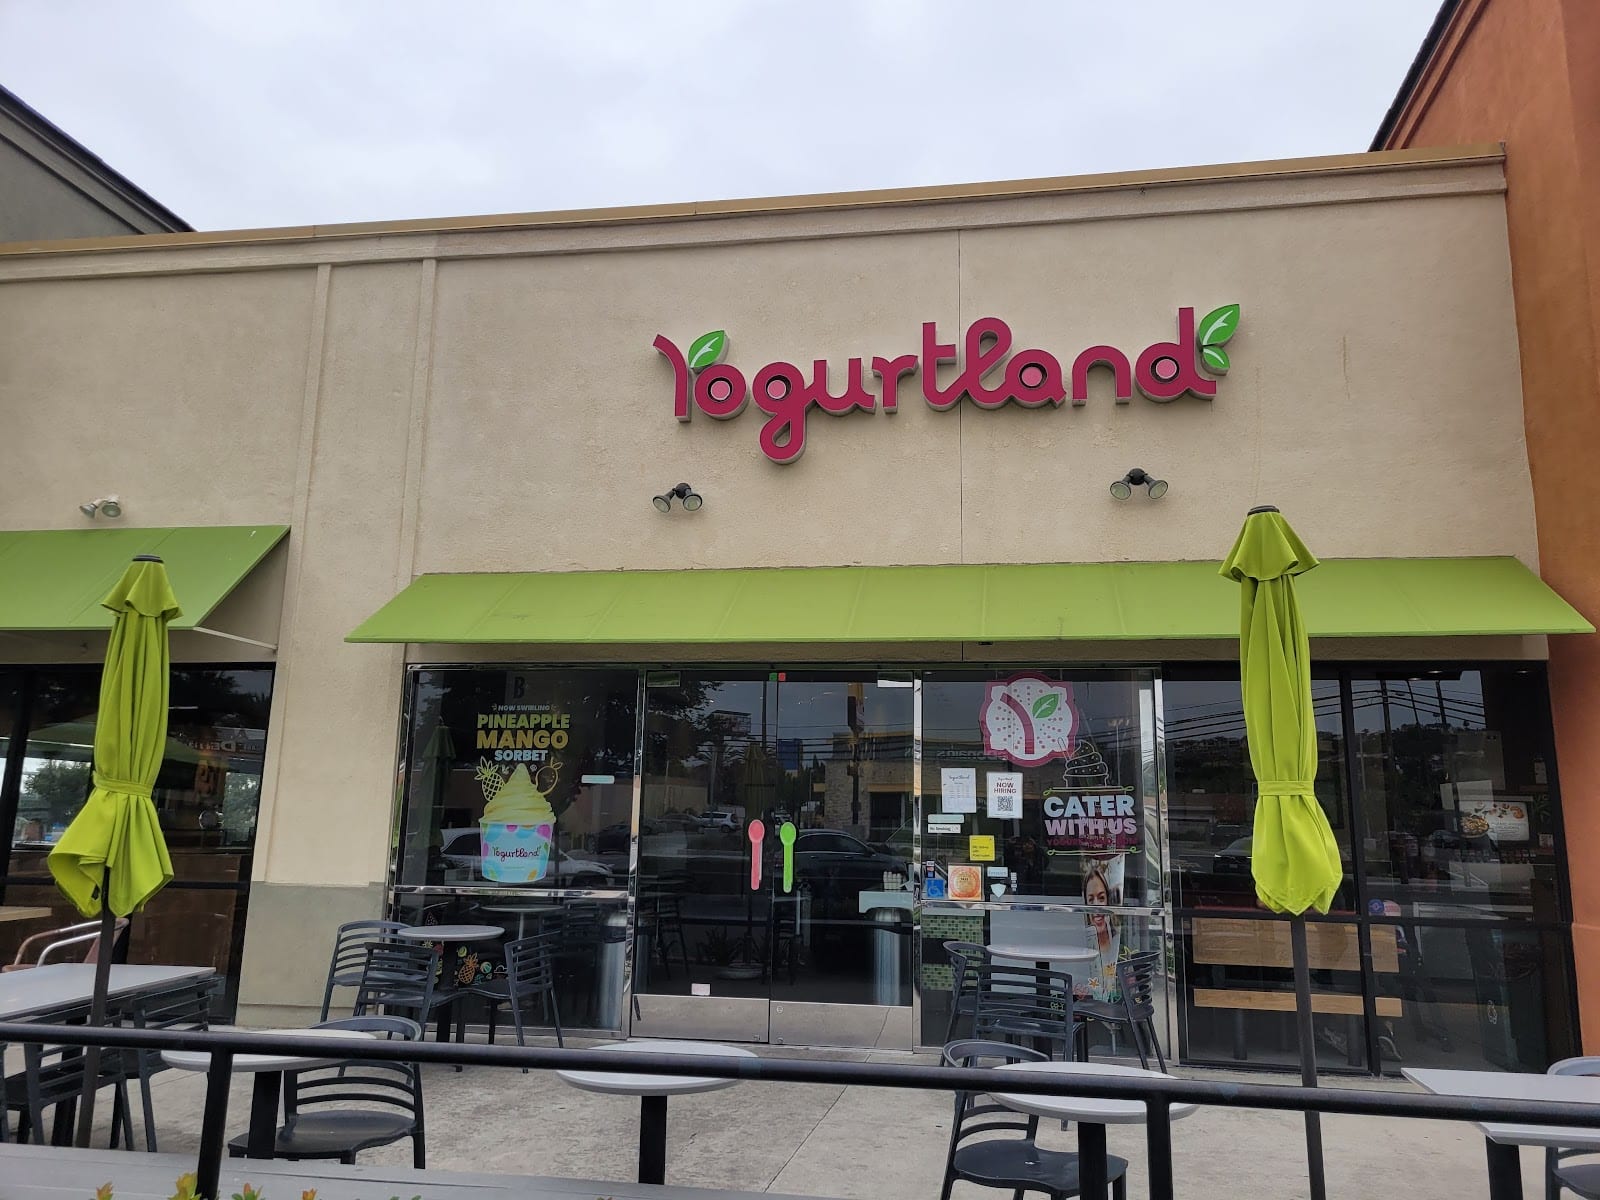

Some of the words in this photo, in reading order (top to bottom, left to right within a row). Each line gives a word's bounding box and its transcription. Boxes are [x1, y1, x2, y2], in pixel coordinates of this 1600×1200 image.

[653, 306, 1220, 463] Yogurtland
[477, 713, 570, 728] PINEAPPLE
[476, 729, 568, 749] MANGO
[494, 749, 548, 761] SORBET
[1043, 794, 1136, 818] CATER
[1044, 818, 1105, 836] WITH
[1107, 817, 1137, 835] US
